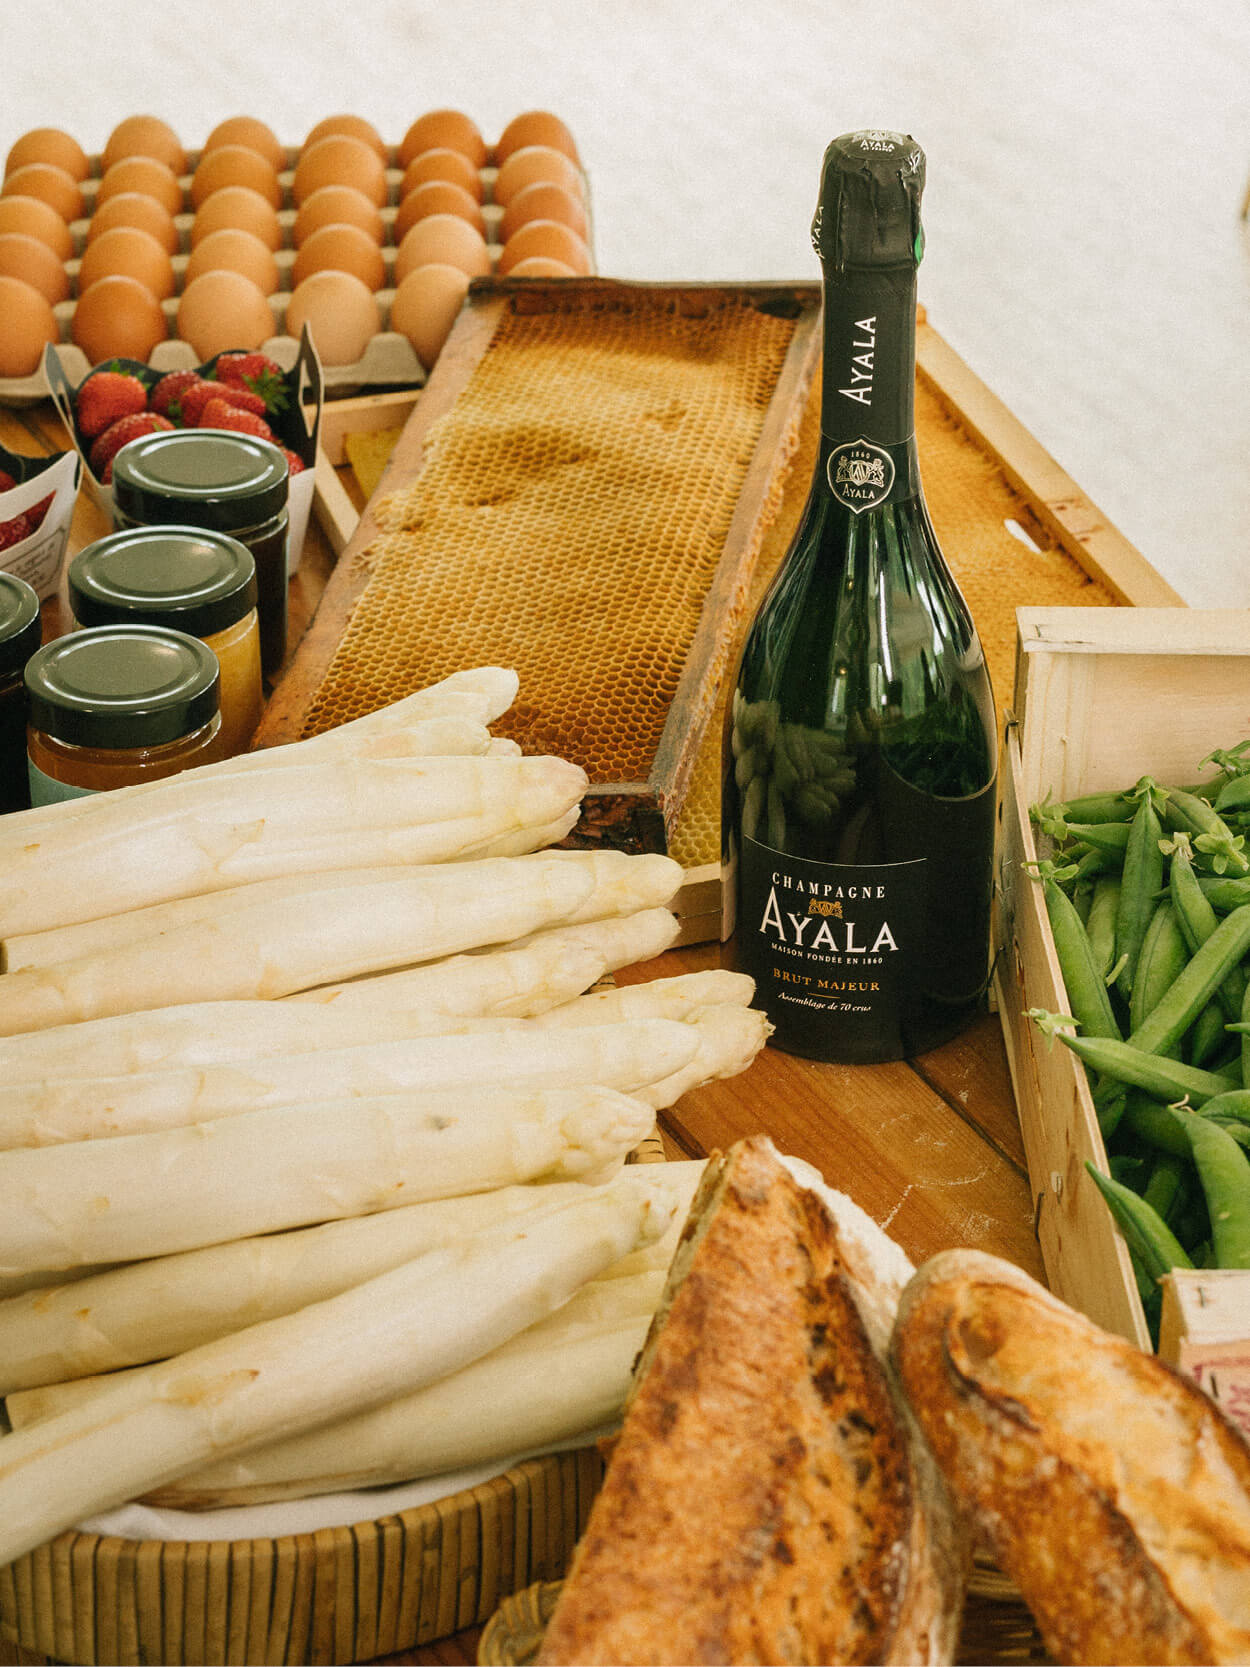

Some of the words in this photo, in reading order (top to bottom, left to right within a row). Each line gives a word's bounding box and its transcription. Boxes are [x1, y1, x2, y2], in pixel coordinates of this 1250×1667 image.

[838, 316, 877, 406] AYALA
[842, 483, 875, 499] AYALA
[772, 872, 886, 899] CHAMPAGNE
[758, 885, 900, 953] AYALA
[771, 942, 803, 957] MAISON
[807, 952, 843, 964] FONDÉE
[846, 957, 858, 965] EN
[862, 957, 883, 965] 1860
[773, 967, 812, 985] BRUT
[817, 979, 880, 991] MAJEUR
[777, 991, 826, 1009] Assemblage
[827, 1001, 838, 1011] de
[840, 1003, 852, 1011] 70
